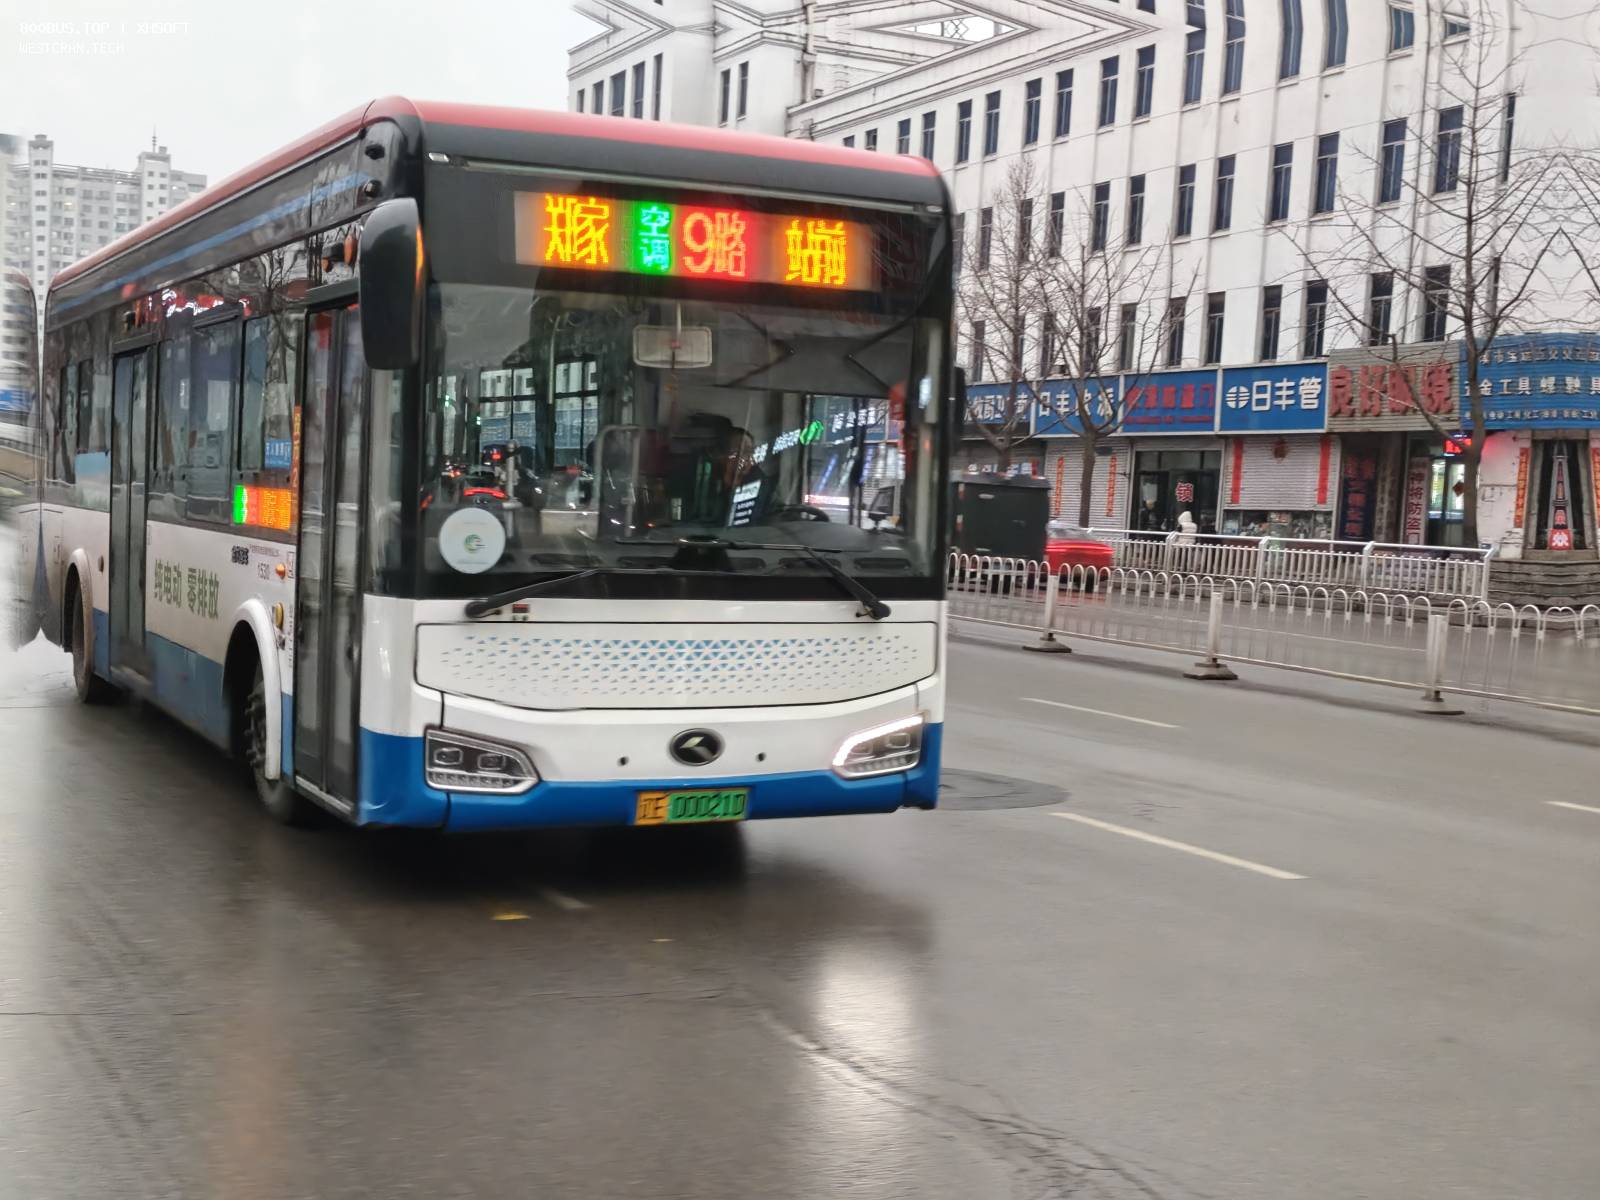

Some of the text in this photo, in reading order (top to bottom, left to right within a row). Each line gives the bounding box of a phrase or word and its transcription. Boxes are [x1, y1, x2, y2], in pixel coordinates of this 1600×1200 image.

[638, 204, 670, 272] 空调
[683, 211, 746, 277] 9路
[1251, 377, 1322, 412] 日丰管
